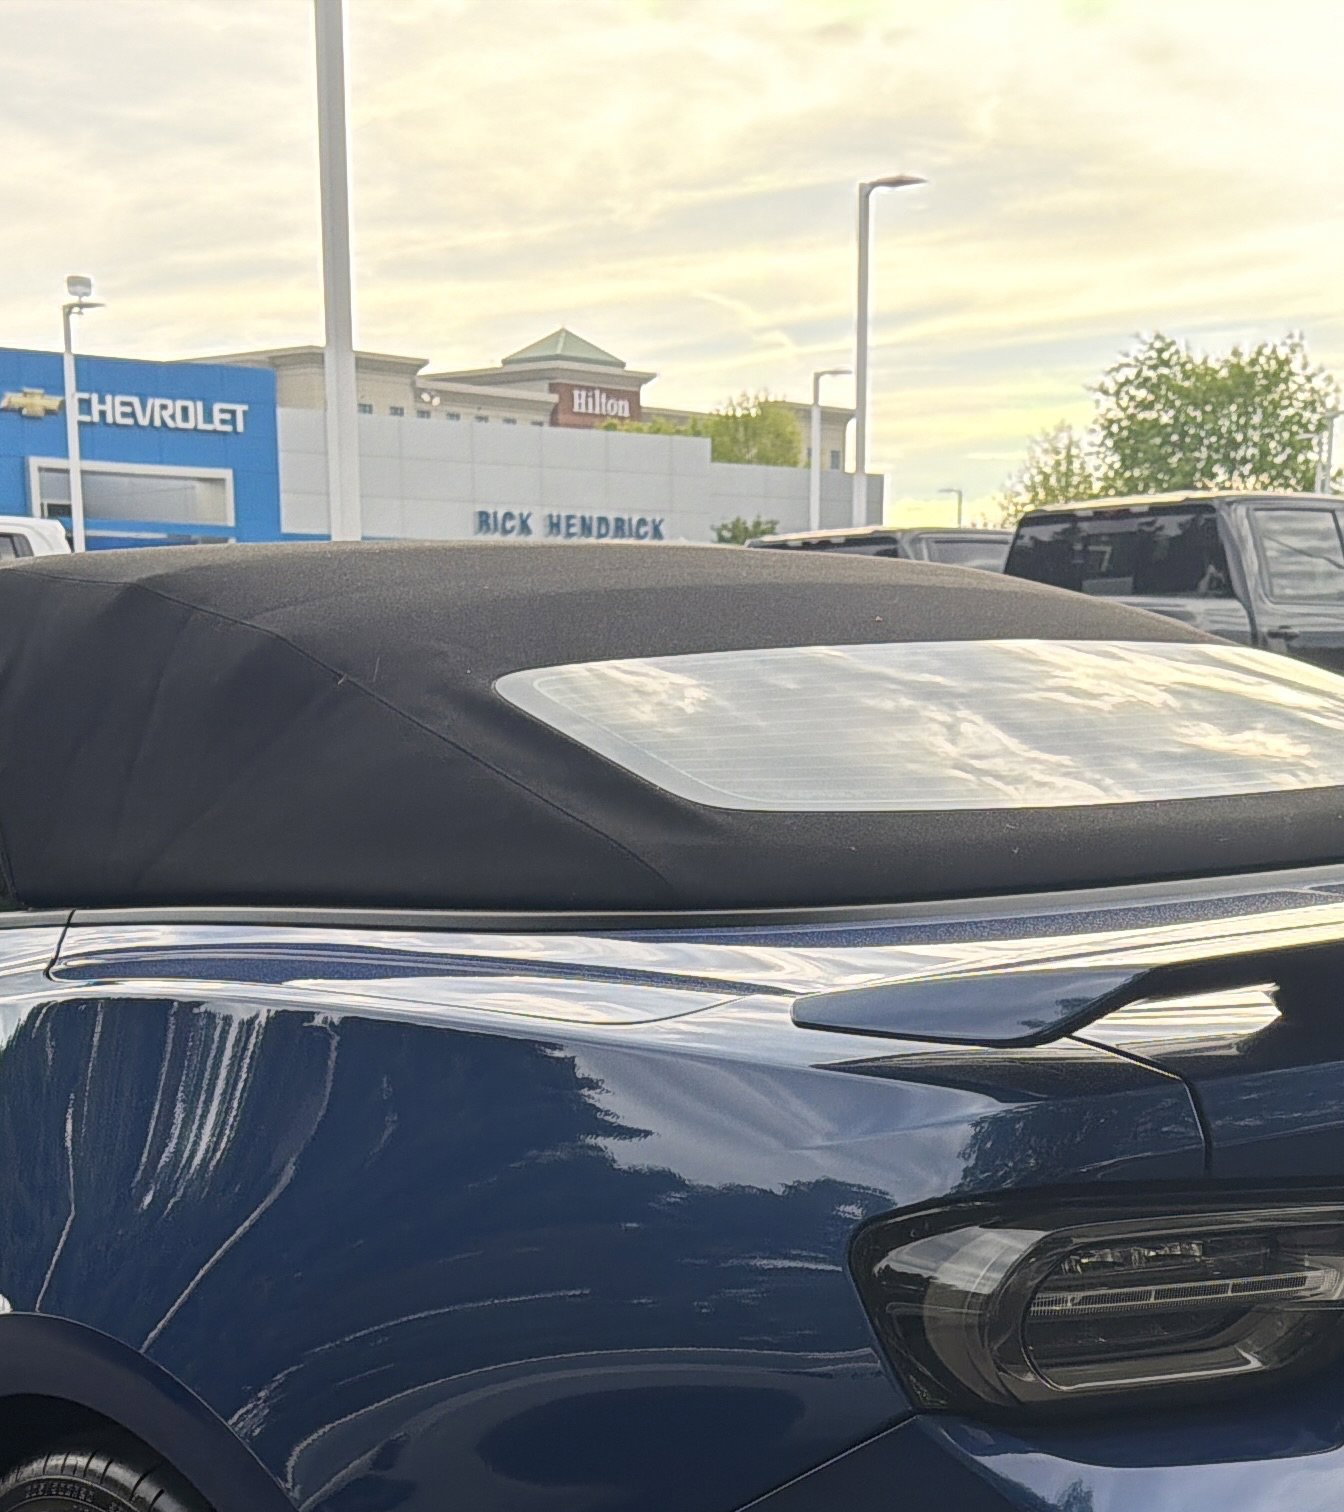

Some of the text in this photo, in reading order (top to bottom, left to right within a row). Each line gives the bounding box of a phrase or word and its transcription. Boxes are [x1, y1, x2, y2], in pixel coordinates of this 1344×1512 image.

[74, 391, 249, 433] CHEVROLET
[572, 389, 631, 418] Hilton
[476, 510, 666, 541] RICK HENDRICK
